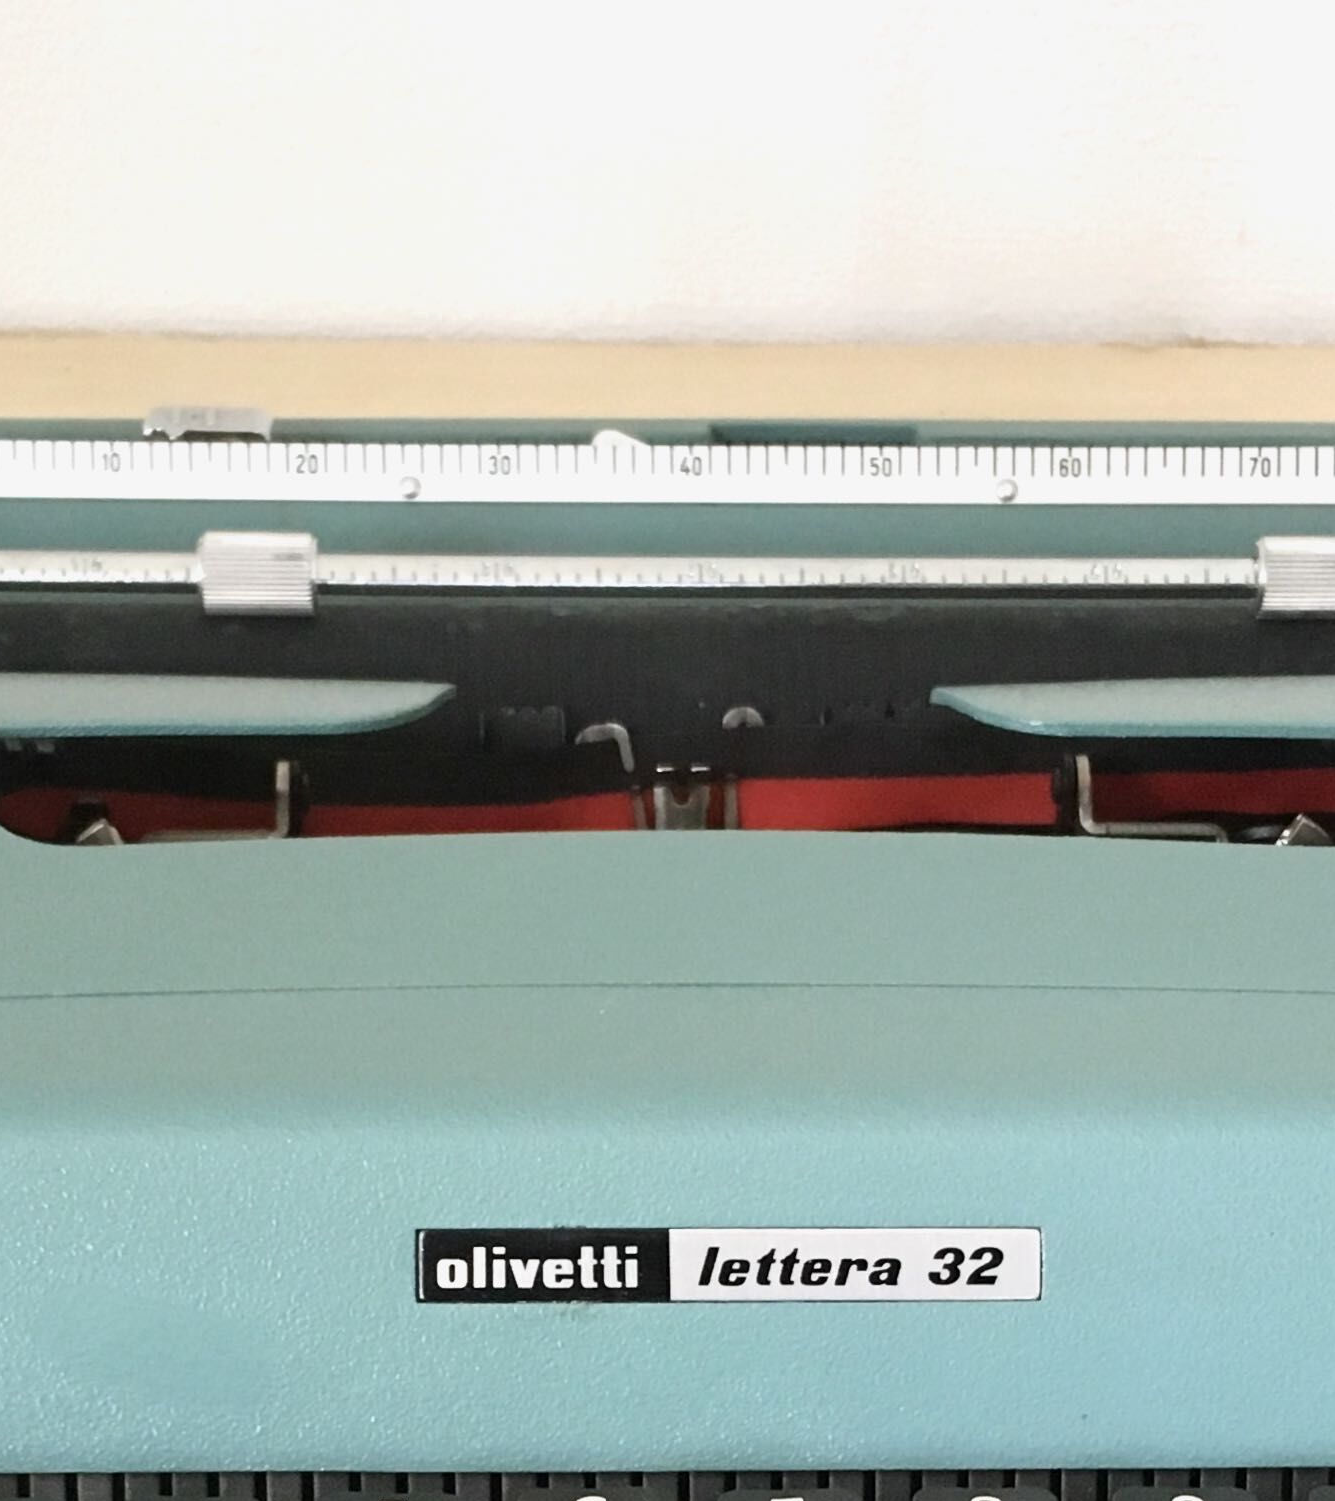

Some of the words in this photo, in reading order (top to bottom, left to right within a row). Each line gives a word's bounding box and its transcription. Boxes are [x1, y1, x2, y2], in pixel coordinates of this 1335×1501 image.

[102, 452, 122, 472] 10
[296, 454, 318, 474] 20
[488, 455, 511, 476] 30
[679, 455, 703, 476] 40
[870, 457, 892, 477] 50
[1059, 457, 1081, 477] 60
[1249, 457, 1271, 478] 70
[436, 1246, 639, 1289] olivetti
[698, 1247, 902, 1287] lettera
[928, 1248, 1005, 1286] 32
